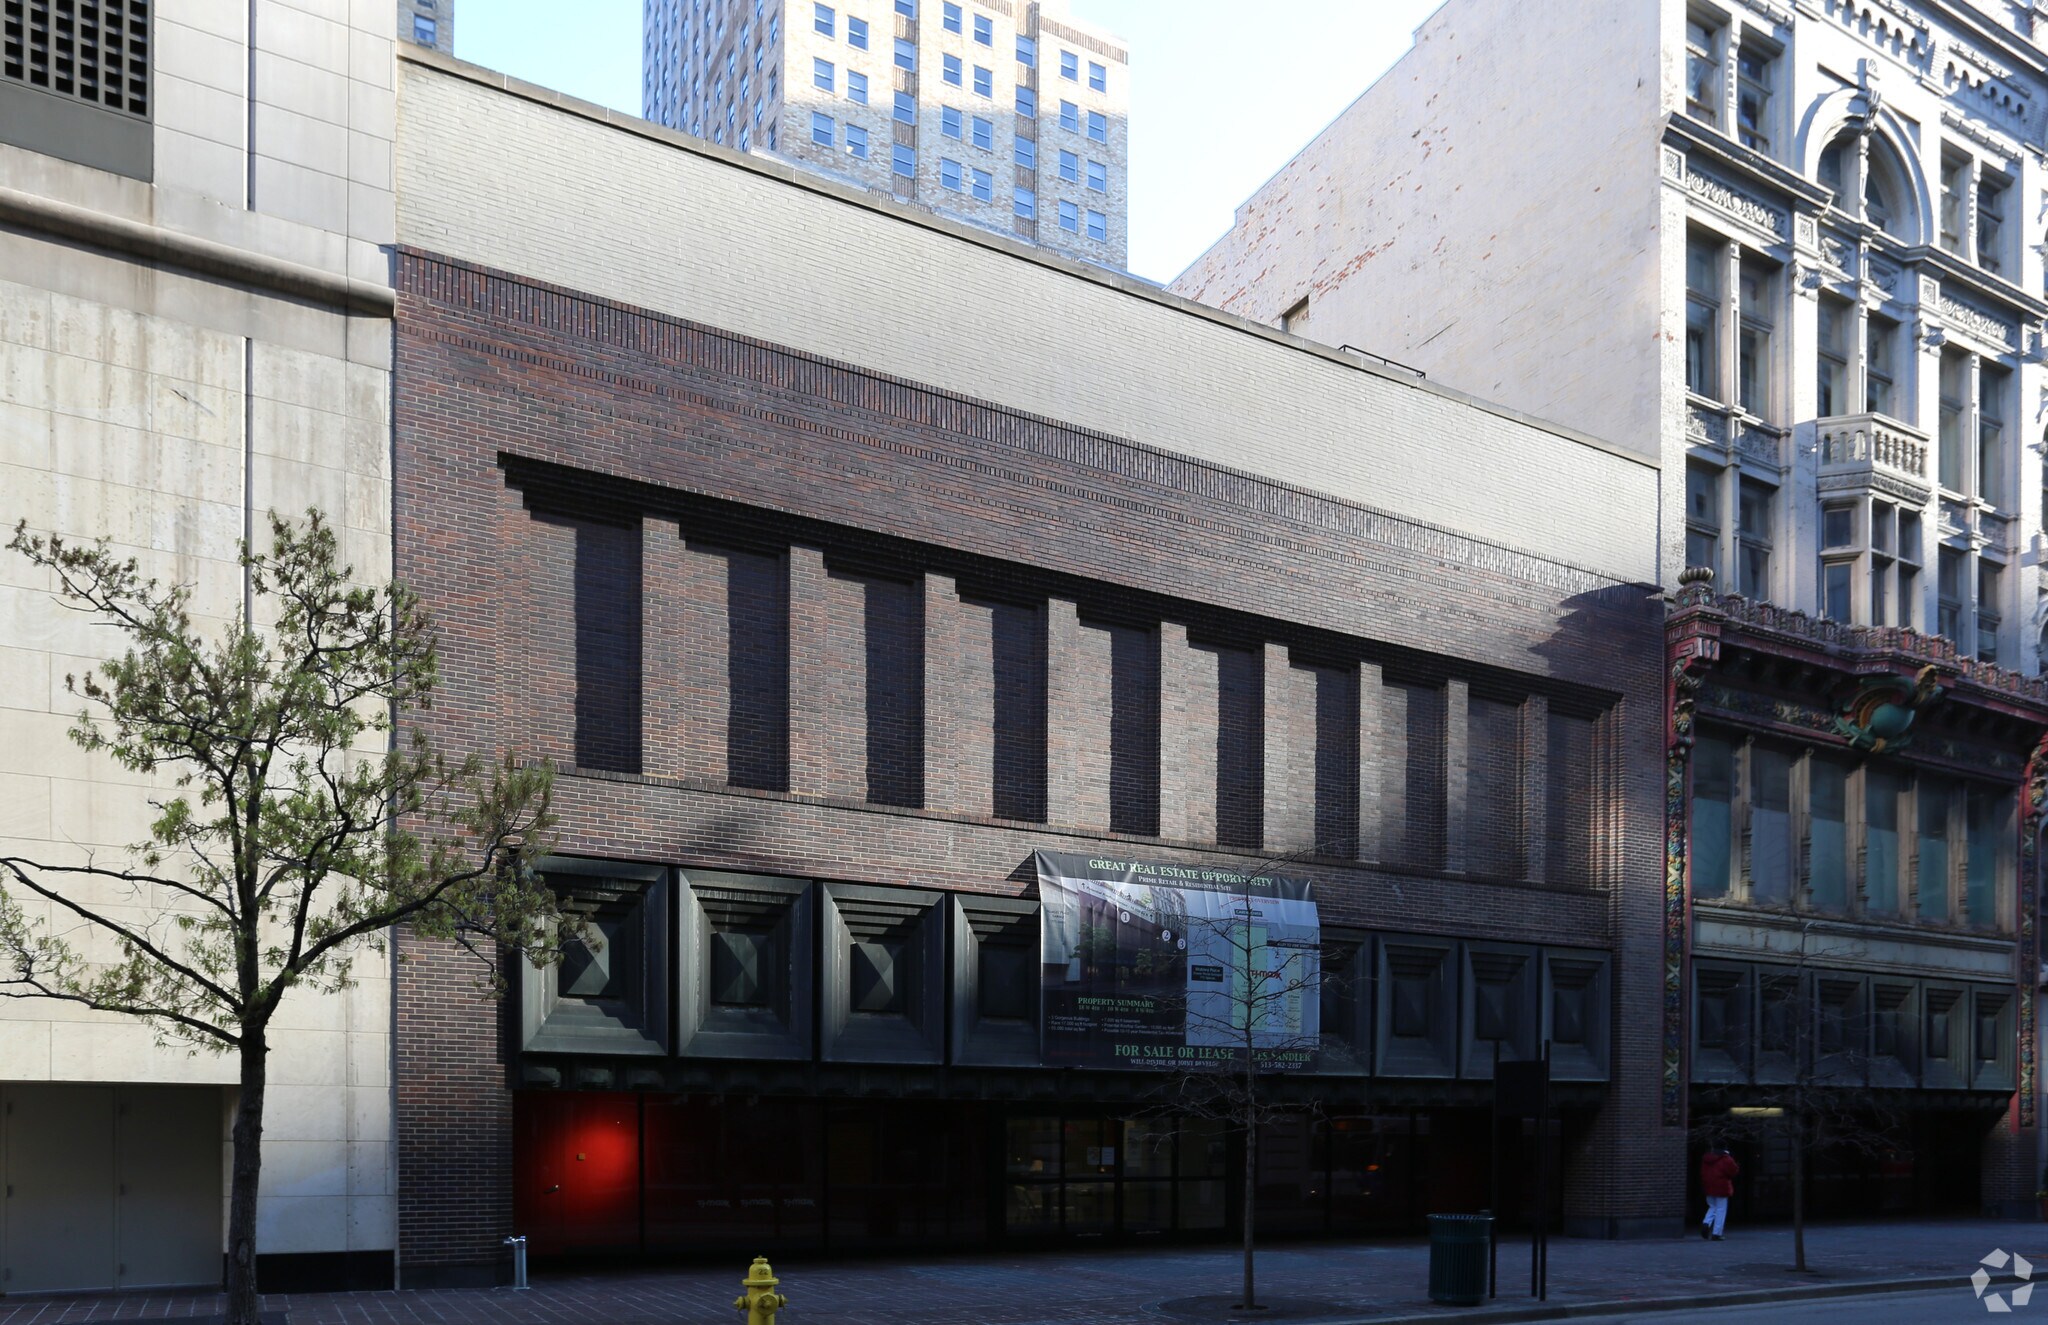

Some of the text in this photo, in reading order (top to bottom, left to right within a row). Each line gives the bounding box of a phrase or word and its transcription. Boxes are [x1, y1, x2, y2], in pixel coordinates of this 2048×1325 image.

[1088, 858, 1273, 887] GREAT REAL ESTATE OPPORTNITY
[1138, 875, 1157, 884] PRIME
[1158, 878, 1178, 887] RETAIL
[1078, 997, 1155, 1008] PROPERTY SUMMARY
[1114, 1044, 1235, 1060] FOR SALE OR LEASE
